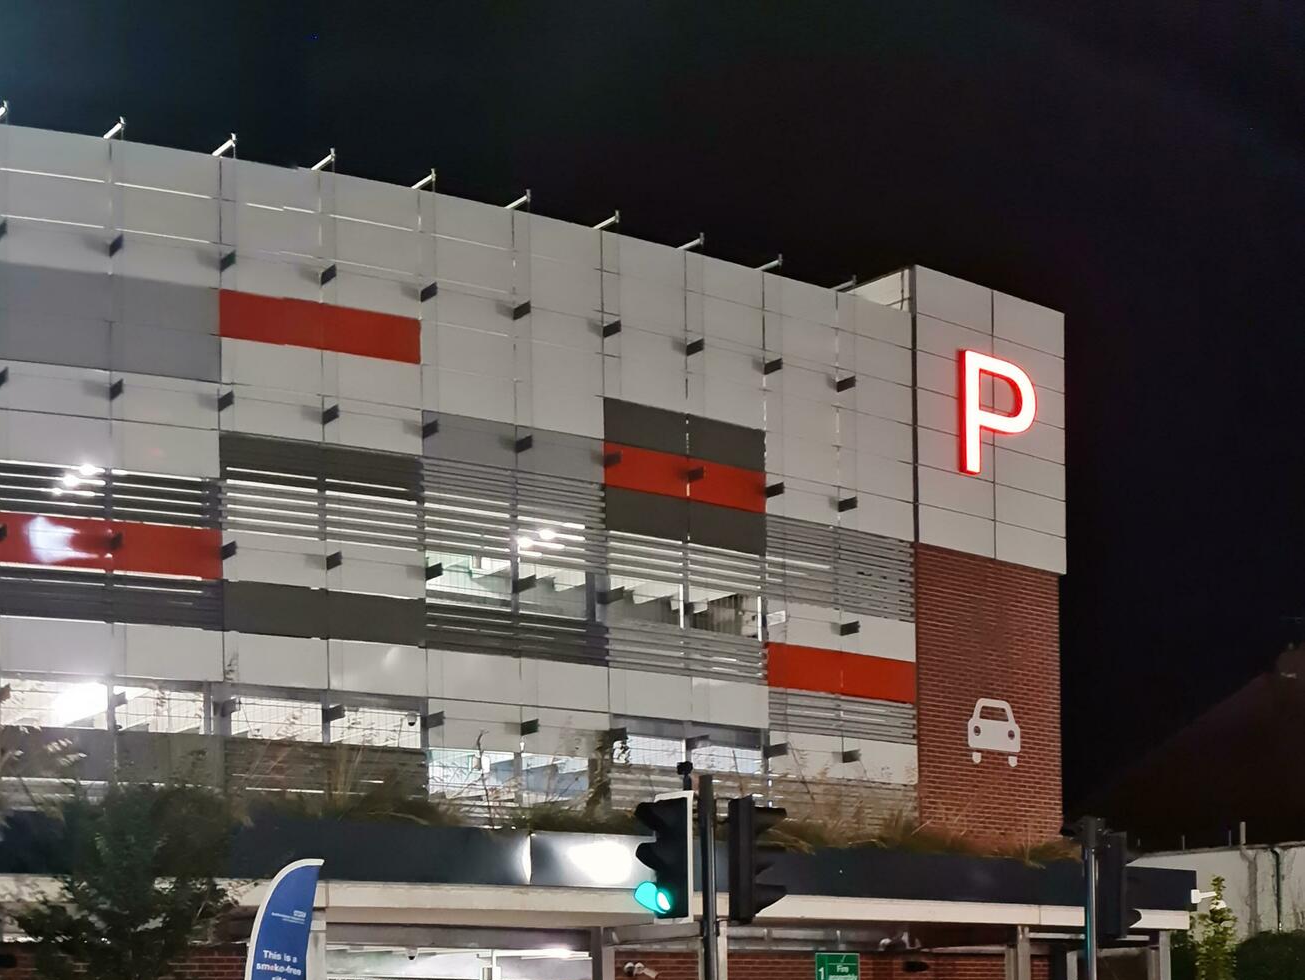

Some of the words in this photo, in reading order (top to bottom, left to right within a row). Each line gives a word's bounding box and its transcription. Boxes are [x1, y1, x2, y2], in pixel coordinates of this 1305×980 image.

[958, 348, 1038, 476] P
[262, 949, 282, 961] This
[284, 952, 291, 962] is
[256, 962, 302, 976] smoke-free
[818, 966, 825, 980] 1
[836, 964, 850, 973] Fire
